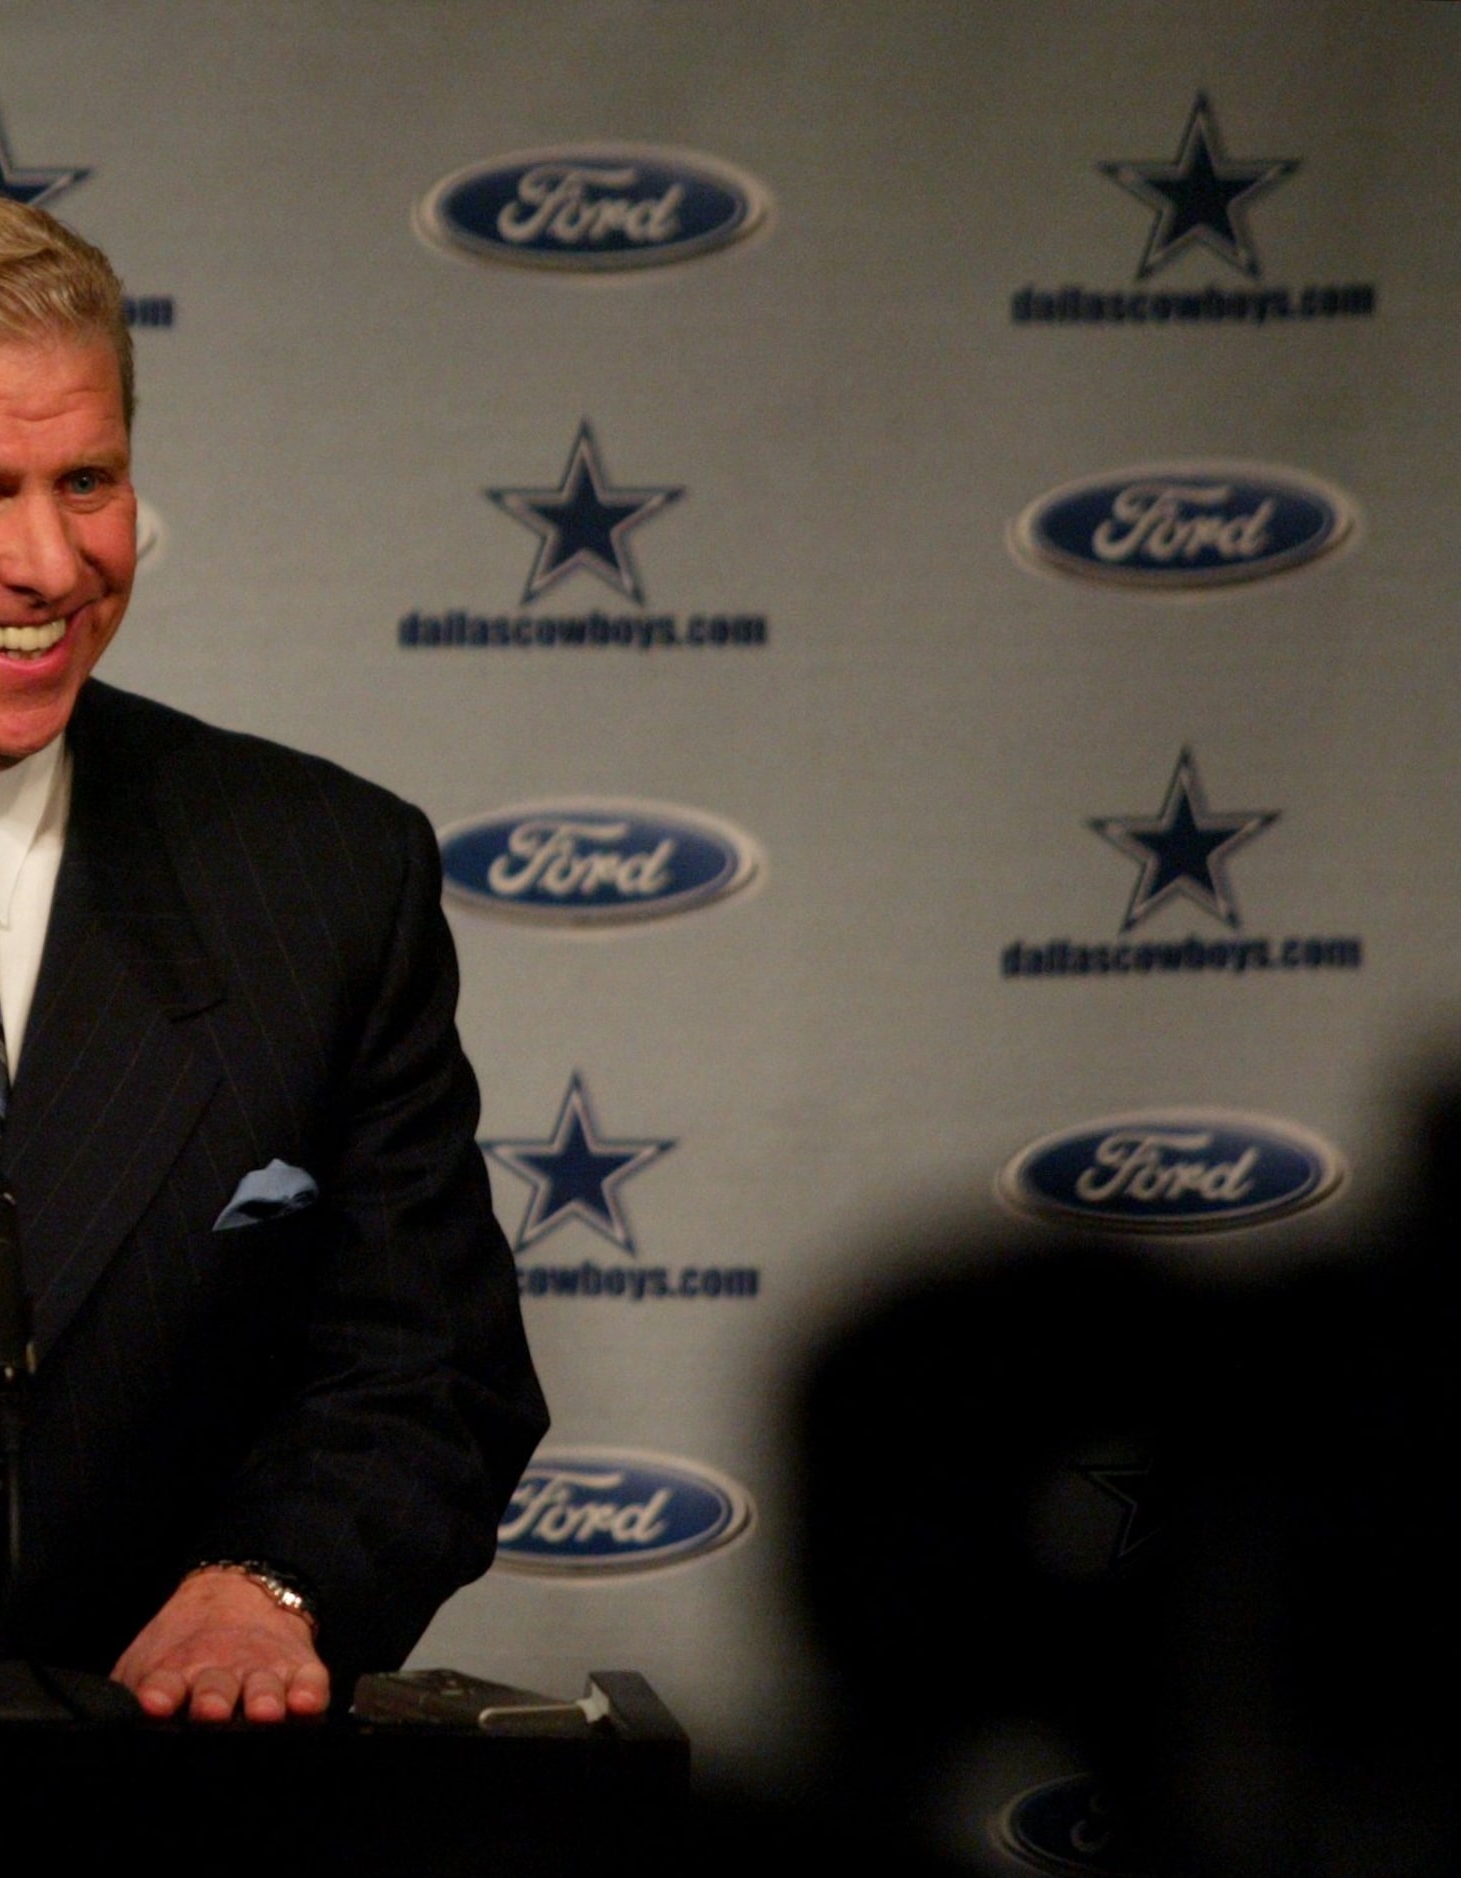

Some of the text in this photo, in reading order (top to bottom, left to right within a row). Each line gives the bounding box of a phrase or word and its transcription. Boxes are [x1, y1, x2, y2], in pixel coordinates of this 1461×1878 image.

[496, 166, 683, 243] Ford
[1011, 282, 1375, 326] dallascowboys.com
[1092, 483, 1278, 560] Ford
[399, 610, 768, 653] dallascowboys.com
[488, 820, 677, 895] Ford
[1001, 934, 1362, 980] dallascowboys.com
[1075, 1131, 1259, 1202] Ford
[516, 1262, 760, 1300] cowboys.com
[498, 1471, 671, 1544] Ford
